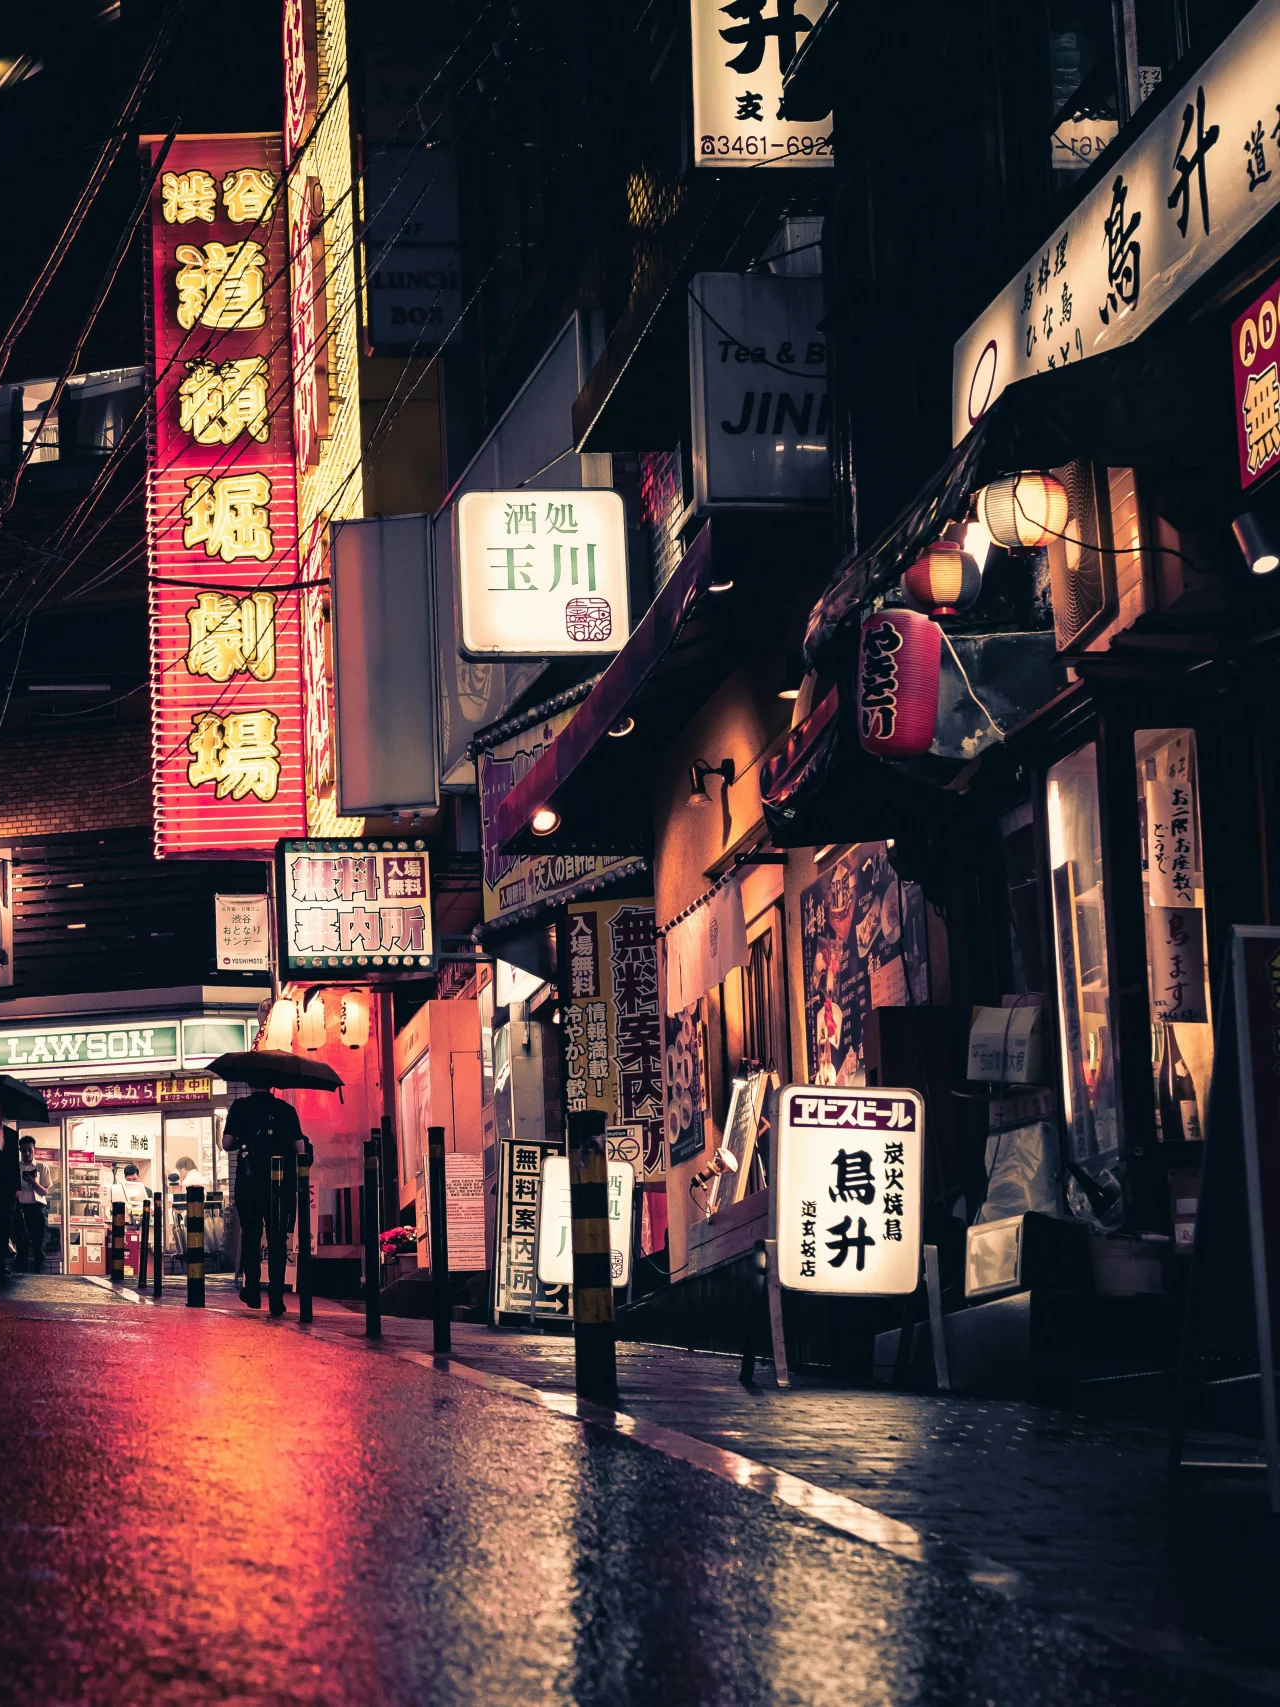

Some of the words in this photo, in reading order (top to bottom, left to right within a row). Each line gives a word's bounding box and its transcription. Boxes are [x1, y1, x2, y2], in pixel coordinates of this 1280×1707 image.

[717, 135, 835, 156] 3461-692
[161, 168, 277, 225] 渋谷
[374, 270, 459, 291] LUNCH
[718, 341, 766, 363] Tea
[776, 342, 796, 364] &
[175, 239, 282, 803] 道頓堀劇場
[504, 503, 579, 535] 酒処
[486, 543, 598, 592] 玉川
[861, 621, 903, 740] やきとり
[291, 856, 381, 902] 無料
[387, 861, 422, 878] 入場
[388, 879, 422, 896] 無料
[223, 925, 261, 935] おとなり
[232, 914, 252, 924] 渋谷
[294, 905, 426, 952] 案内所
[223, 937, 262, 946] サンデー
[570, 915, 596, 998] 入場無料
[231, 957, 263, 965] YOSHIMOTO
[7, 1030, 155, 1064] LAWSON
[587, 1001, 610, 1098] 情報満載!
[85, 1089, 100, 1103] 新
[160, 1078, 210, 1093] 増量中!!
[513, 1148, 538, 1293] 無料案内所
[825, 1148, 875, 1271] 鳥升
